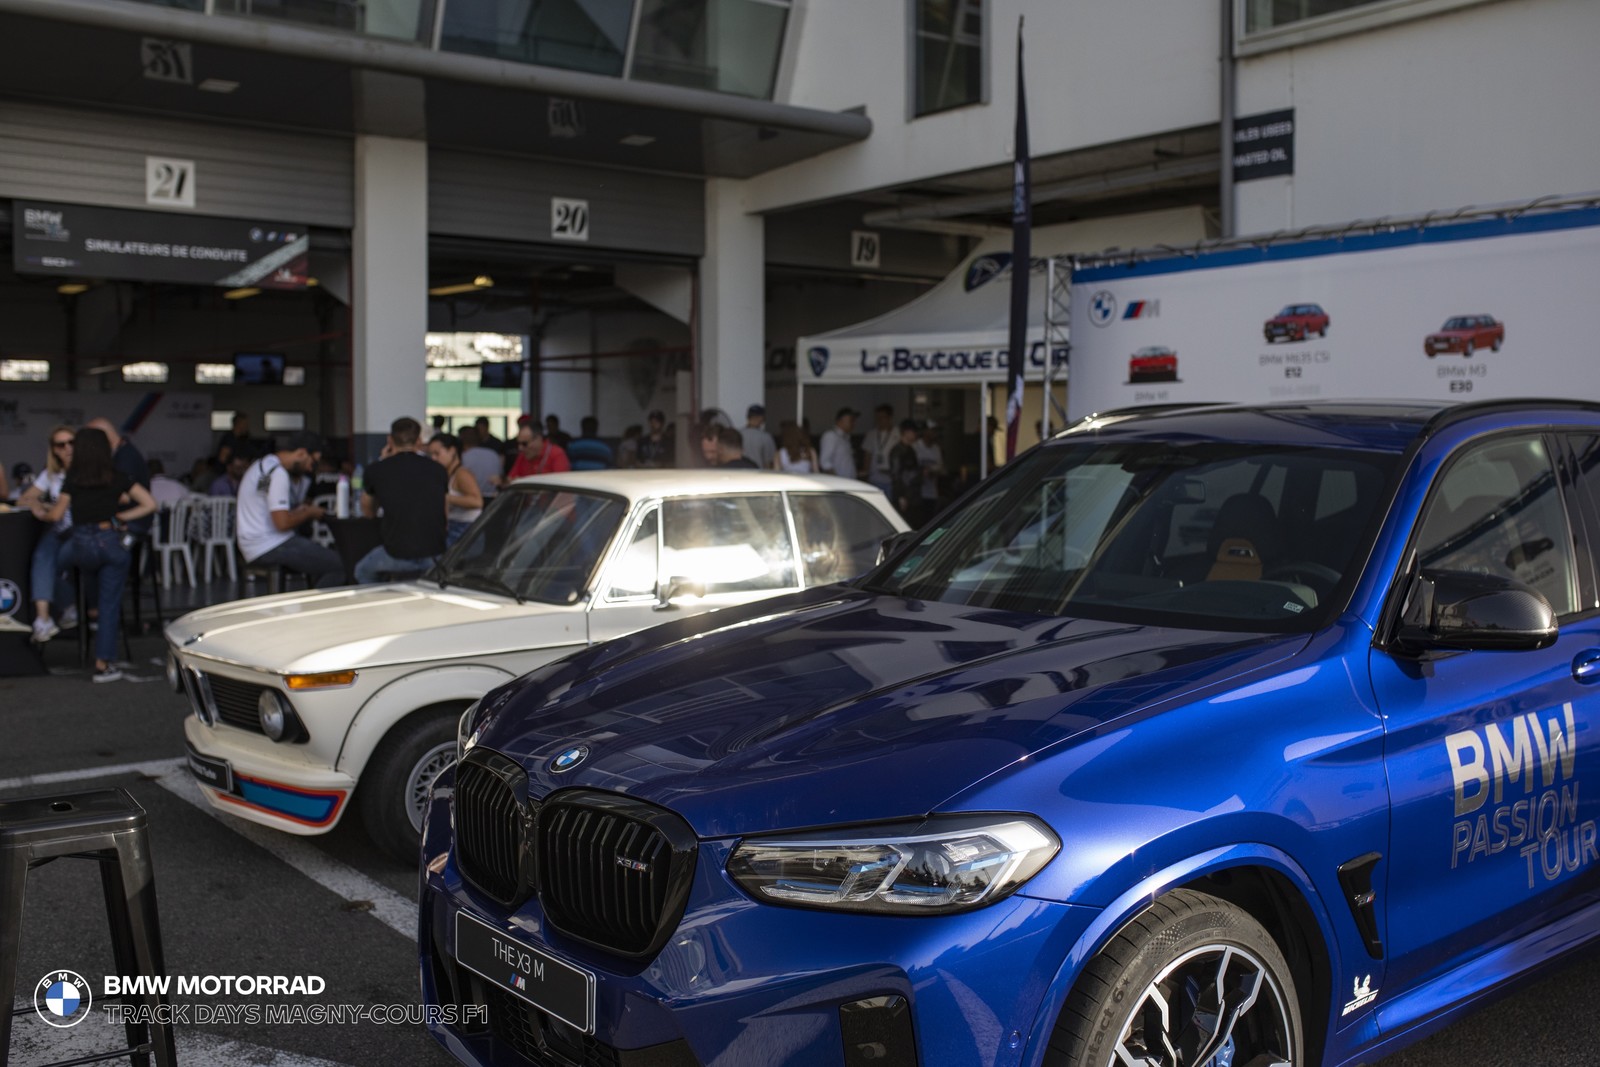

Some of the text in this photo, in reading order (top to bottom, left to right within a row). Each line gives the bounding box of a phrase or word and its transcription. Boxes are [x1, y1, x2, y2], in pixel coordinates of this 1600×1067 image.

[152, 163, 188, 199] 21
[24, 208, 63, 224] BMW
[555, 203, 587, 236] 20
[85, 238, 248, 263] SIMULATEURS DE CONDUITE
[855, 235, 877, 263] 19
[1258, 354, 1283, 366] BMW
[1284, 367, 1303, 379] E12
[1436, 364, 1488, 379] BMW M3
[1448, 380, 1473, 394] E30
[1444, 701, 1578, 817] BMW
[1450, 780, 1580, 870] PASSION
[1520, 819, 1600, 890] TOUR
[491, 937, 545, 982] THE X3 M
[1086, 1007, 1115, 1067] ntact
